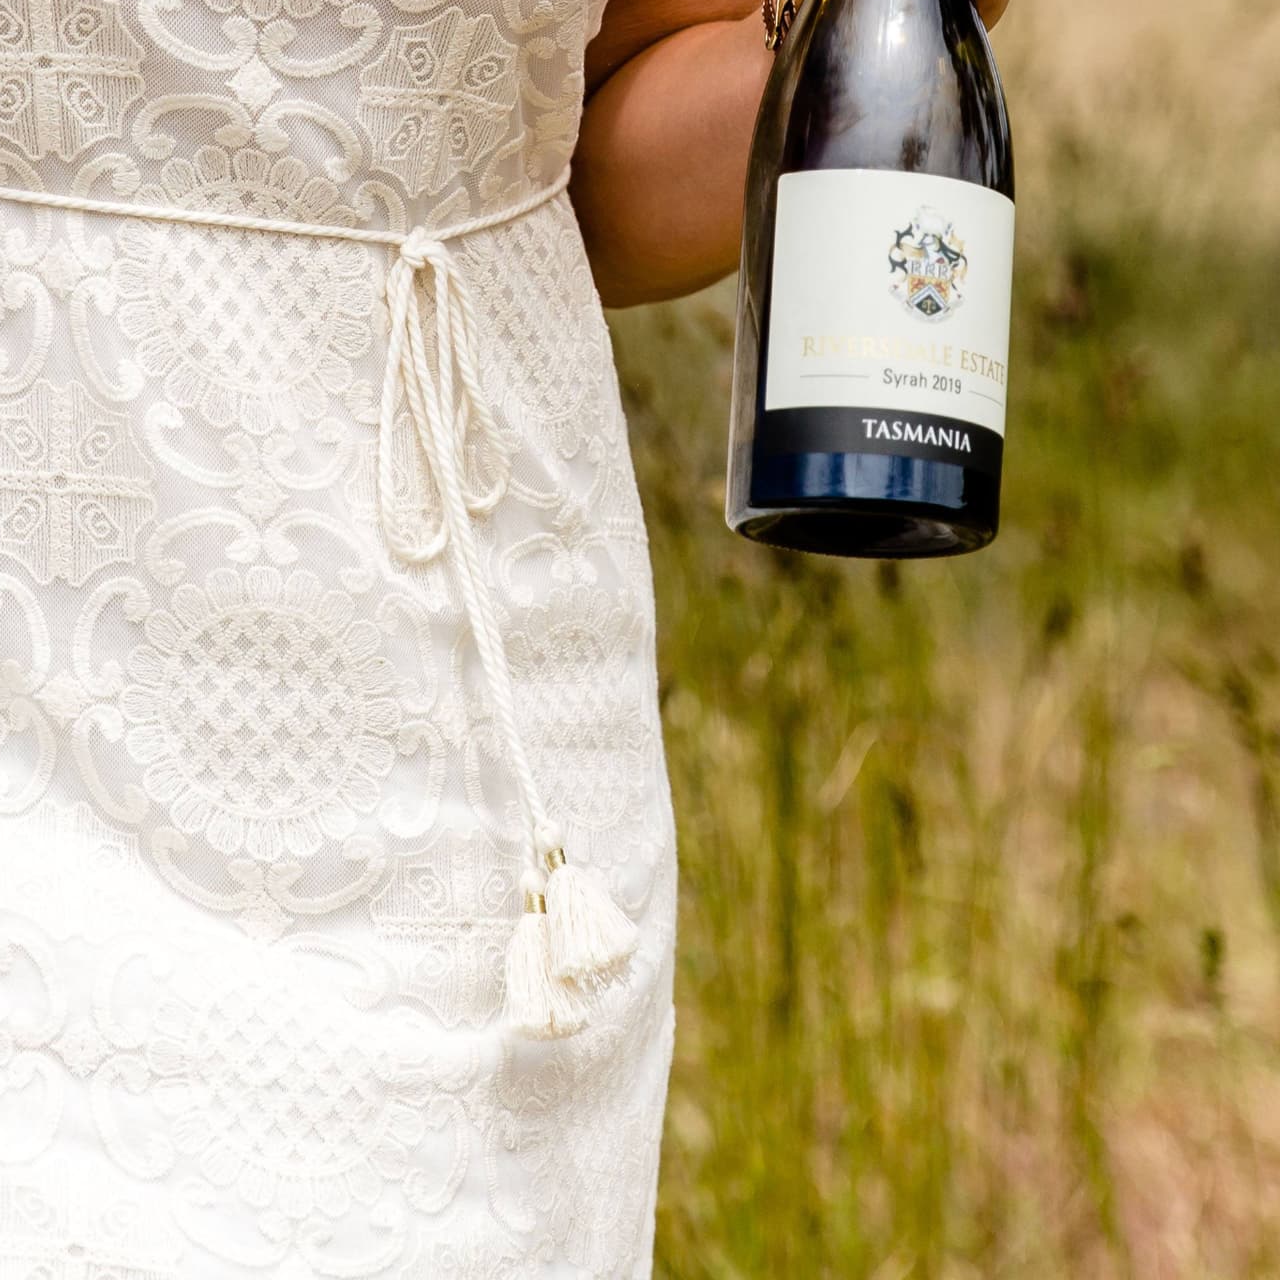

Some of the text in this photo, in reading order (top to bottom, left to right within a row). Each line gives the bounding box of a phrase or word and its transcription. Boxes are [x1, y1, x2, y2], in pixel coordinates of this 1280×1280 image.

[883, 368, 962, 394] Syrah 2019
[960, 350, 1006, 385] ESTATE
[862, 419, 972, 452] TASMANIA
